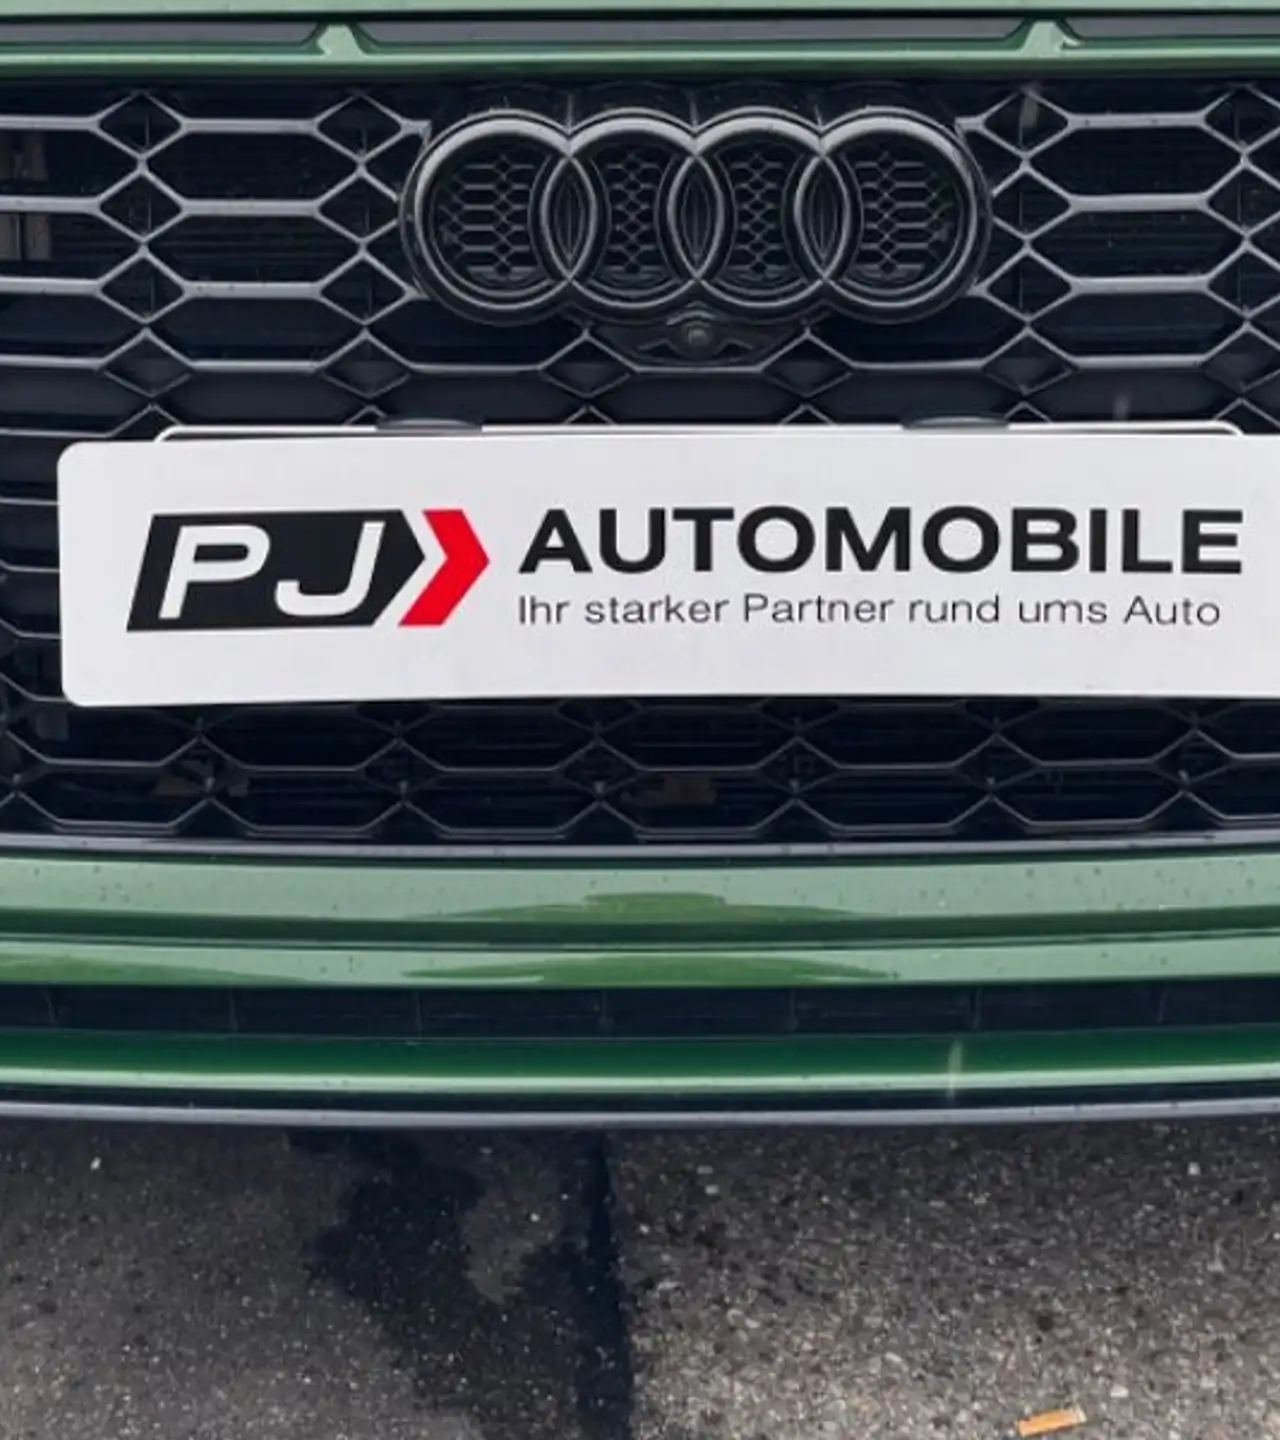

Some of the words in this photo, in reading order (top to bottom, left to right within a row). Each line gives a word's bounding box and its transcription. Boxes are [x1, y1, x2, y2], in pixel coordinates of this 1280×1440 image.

[158, 521, 386, 619] PJ
[518, 505, 1244, 576] AUTOMOBILE
[518, 594, 571, 626] Ihr
[585, 593, 730, 626] starker
[743, 591, 896, 624] Partner
[908, 593, 1001, 625] rund
[1017, 599, 1109, 625] ums
[1122, 594, 1221, 627] Auto
